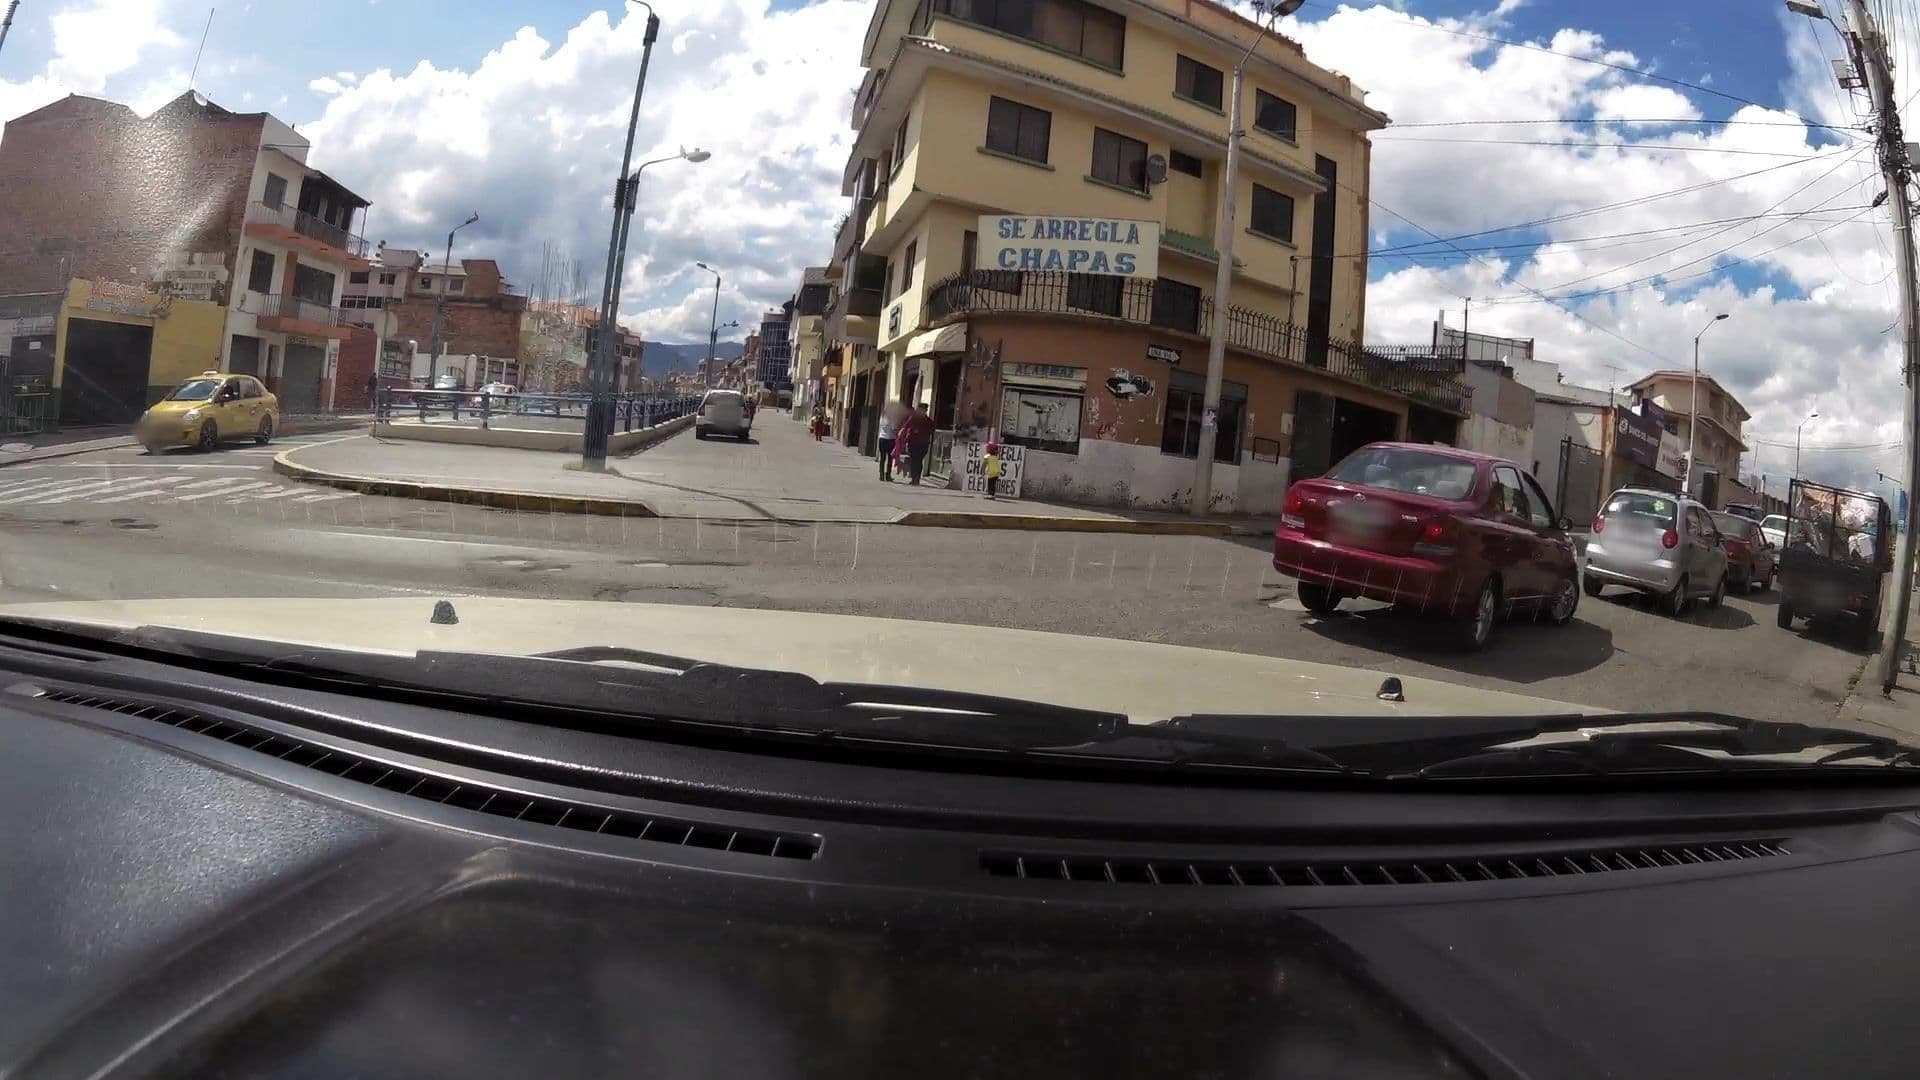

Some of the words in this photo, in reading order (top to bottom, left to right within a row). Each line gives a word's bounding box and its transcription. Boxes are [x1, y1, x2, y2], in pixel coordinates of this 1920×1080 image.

[998, 218, 1027, 240] SE
[1031, 219, 1140, 245] ARREGLA
[998, 247, 1137, 274] CHAPAS
[968, 443, 980, 458] SE
[966, 460, 1007, 477] CHS
[1015, 463, 1021, 478] Y
